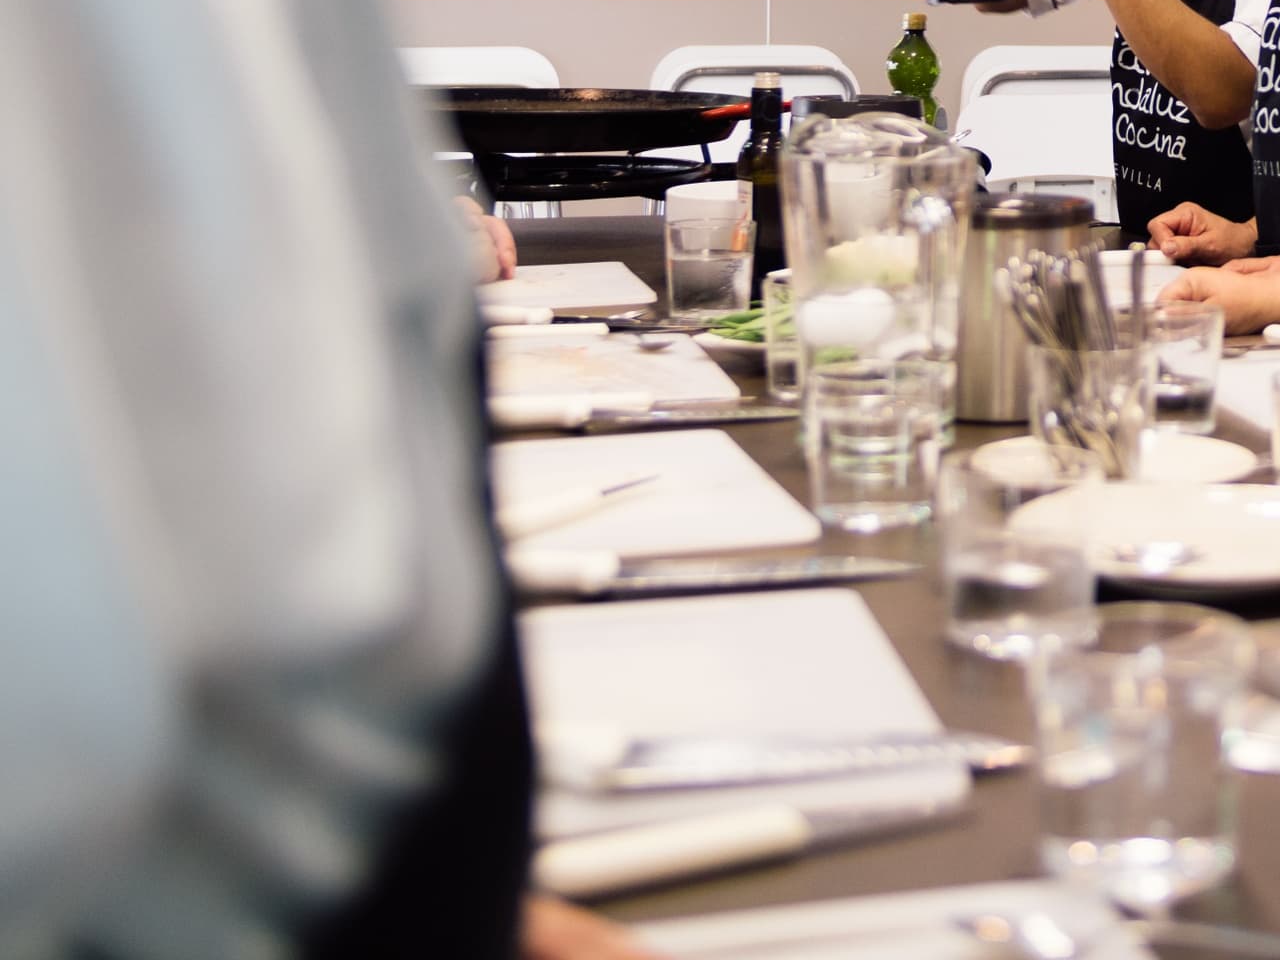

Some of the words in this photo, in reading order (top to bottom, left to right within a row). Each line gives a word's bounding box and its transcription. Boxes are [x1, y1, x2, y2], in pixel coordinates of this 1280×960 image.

[1112, 77, 1191, 124] ndaluz
[1115, 112, 1187, 161] Cocina
[1114, 162, 1163, 193] EVILLA
